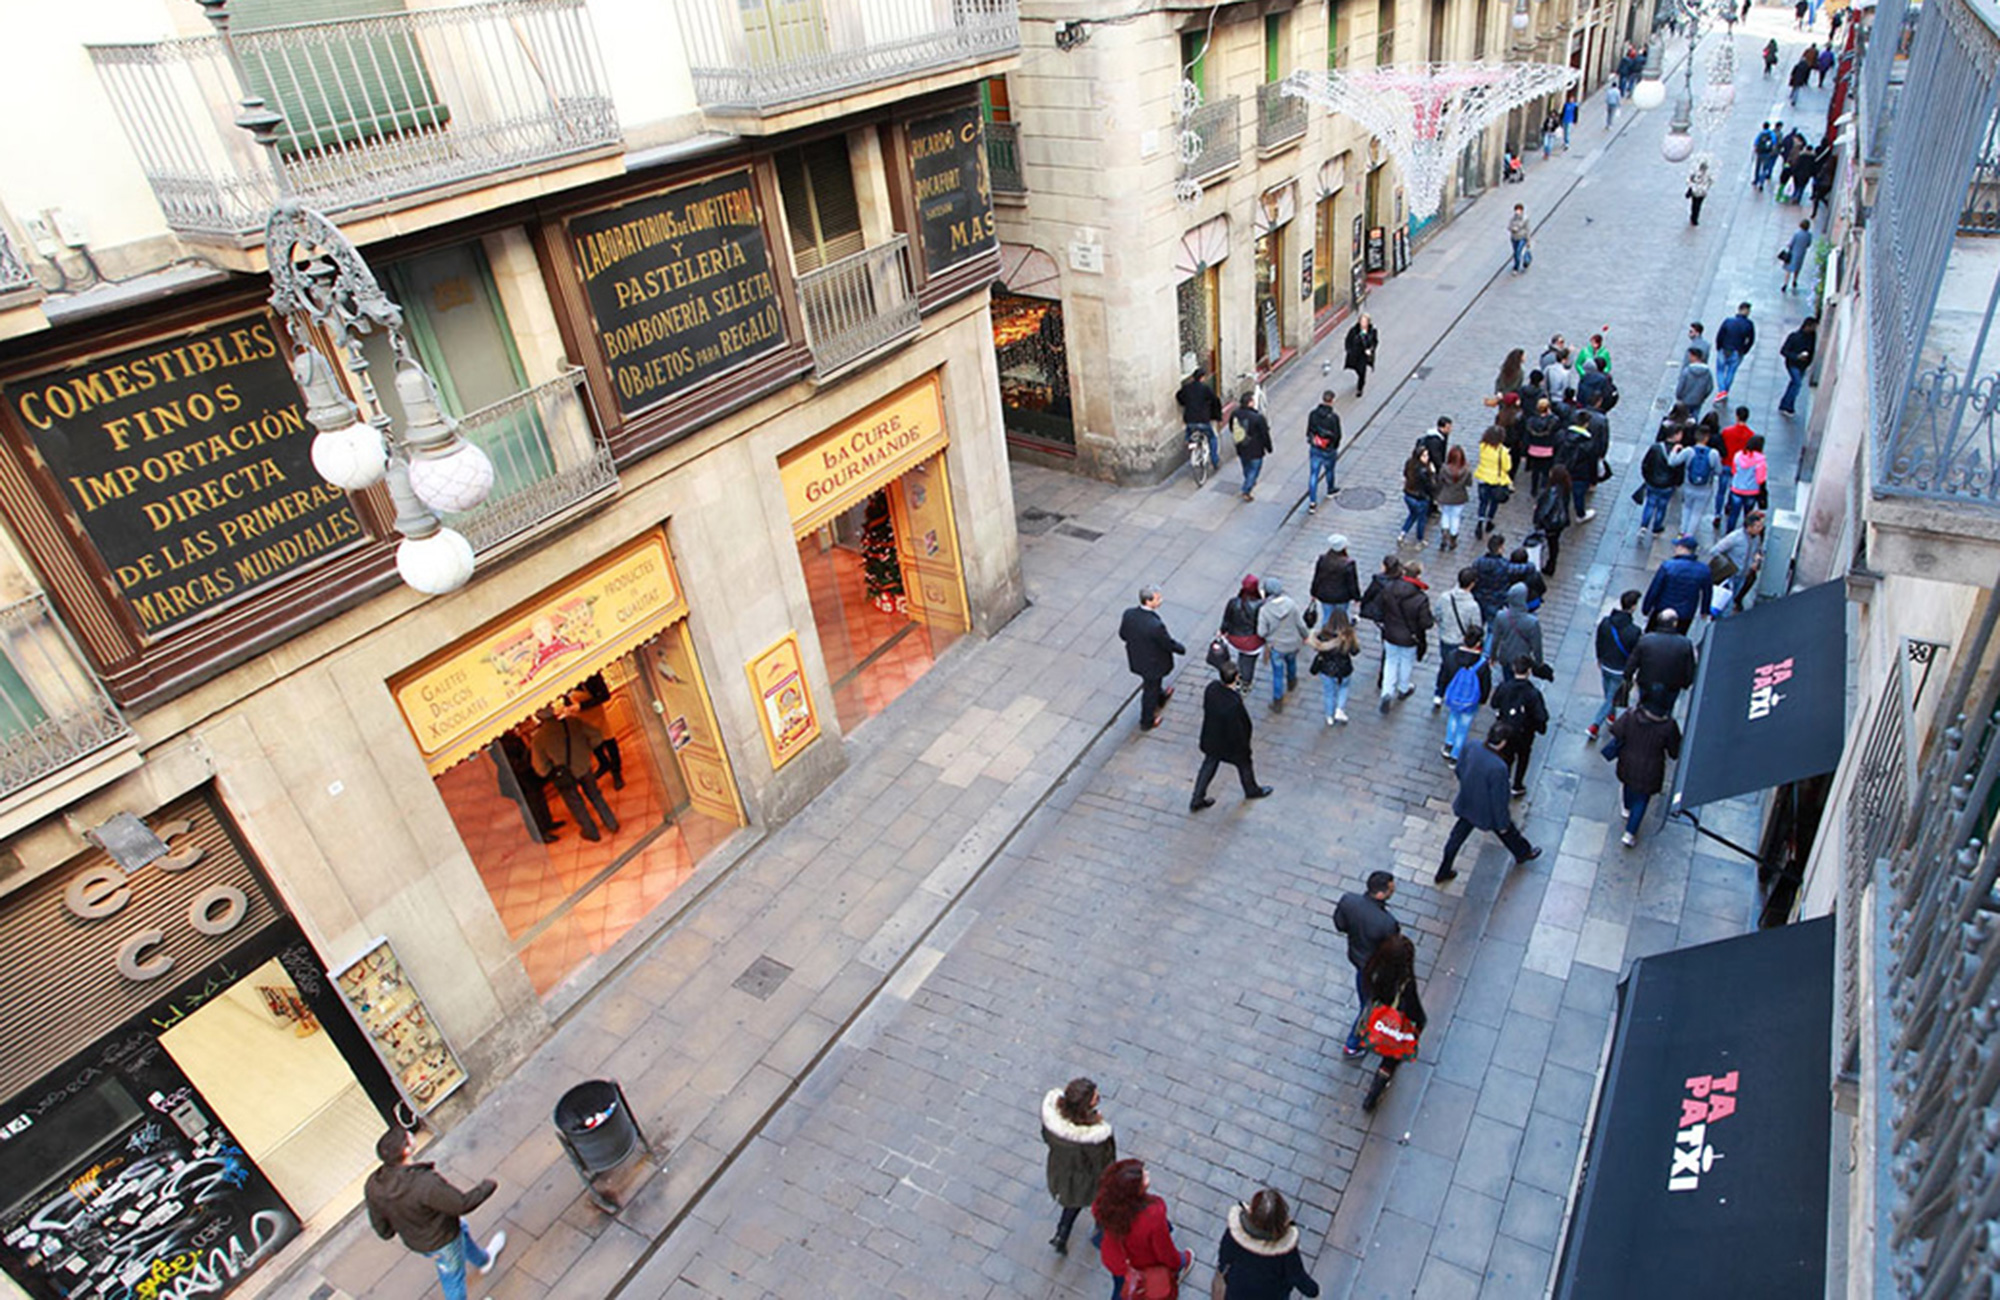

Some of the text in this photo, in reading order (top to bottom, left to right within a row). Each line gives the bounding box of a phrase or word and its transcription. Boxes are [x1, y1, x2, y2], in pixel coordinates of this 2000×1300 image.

[576, 210, 677, 280] LABORATORIOS
[671, 242, 683, 257] Y
[950, 211, 996, 251] MAS
[614, 238, 746, 309] PASTELERÍA
[604, 272, 773, 360] BOMBONERÍA SELECTA
[618, 347, 695, 398] OBJETOS
[719, 304, 778, 355] REGALO
[19, 323, 276, 430] COMESTIBLES
[103, 384, 241, 450] FINOS
[851, 415, 902, 453] CURE
[69, 403, 306, 512] IMPORTACIÓN
[143, 458, 286, 531] DIRECTA
[805, 425, 920, 503] GOURMANDE
[116, 483, 343, 588] DE LAS PRIMERAS
[131, 507, 360, 628] MARCAS MUNDIALES
